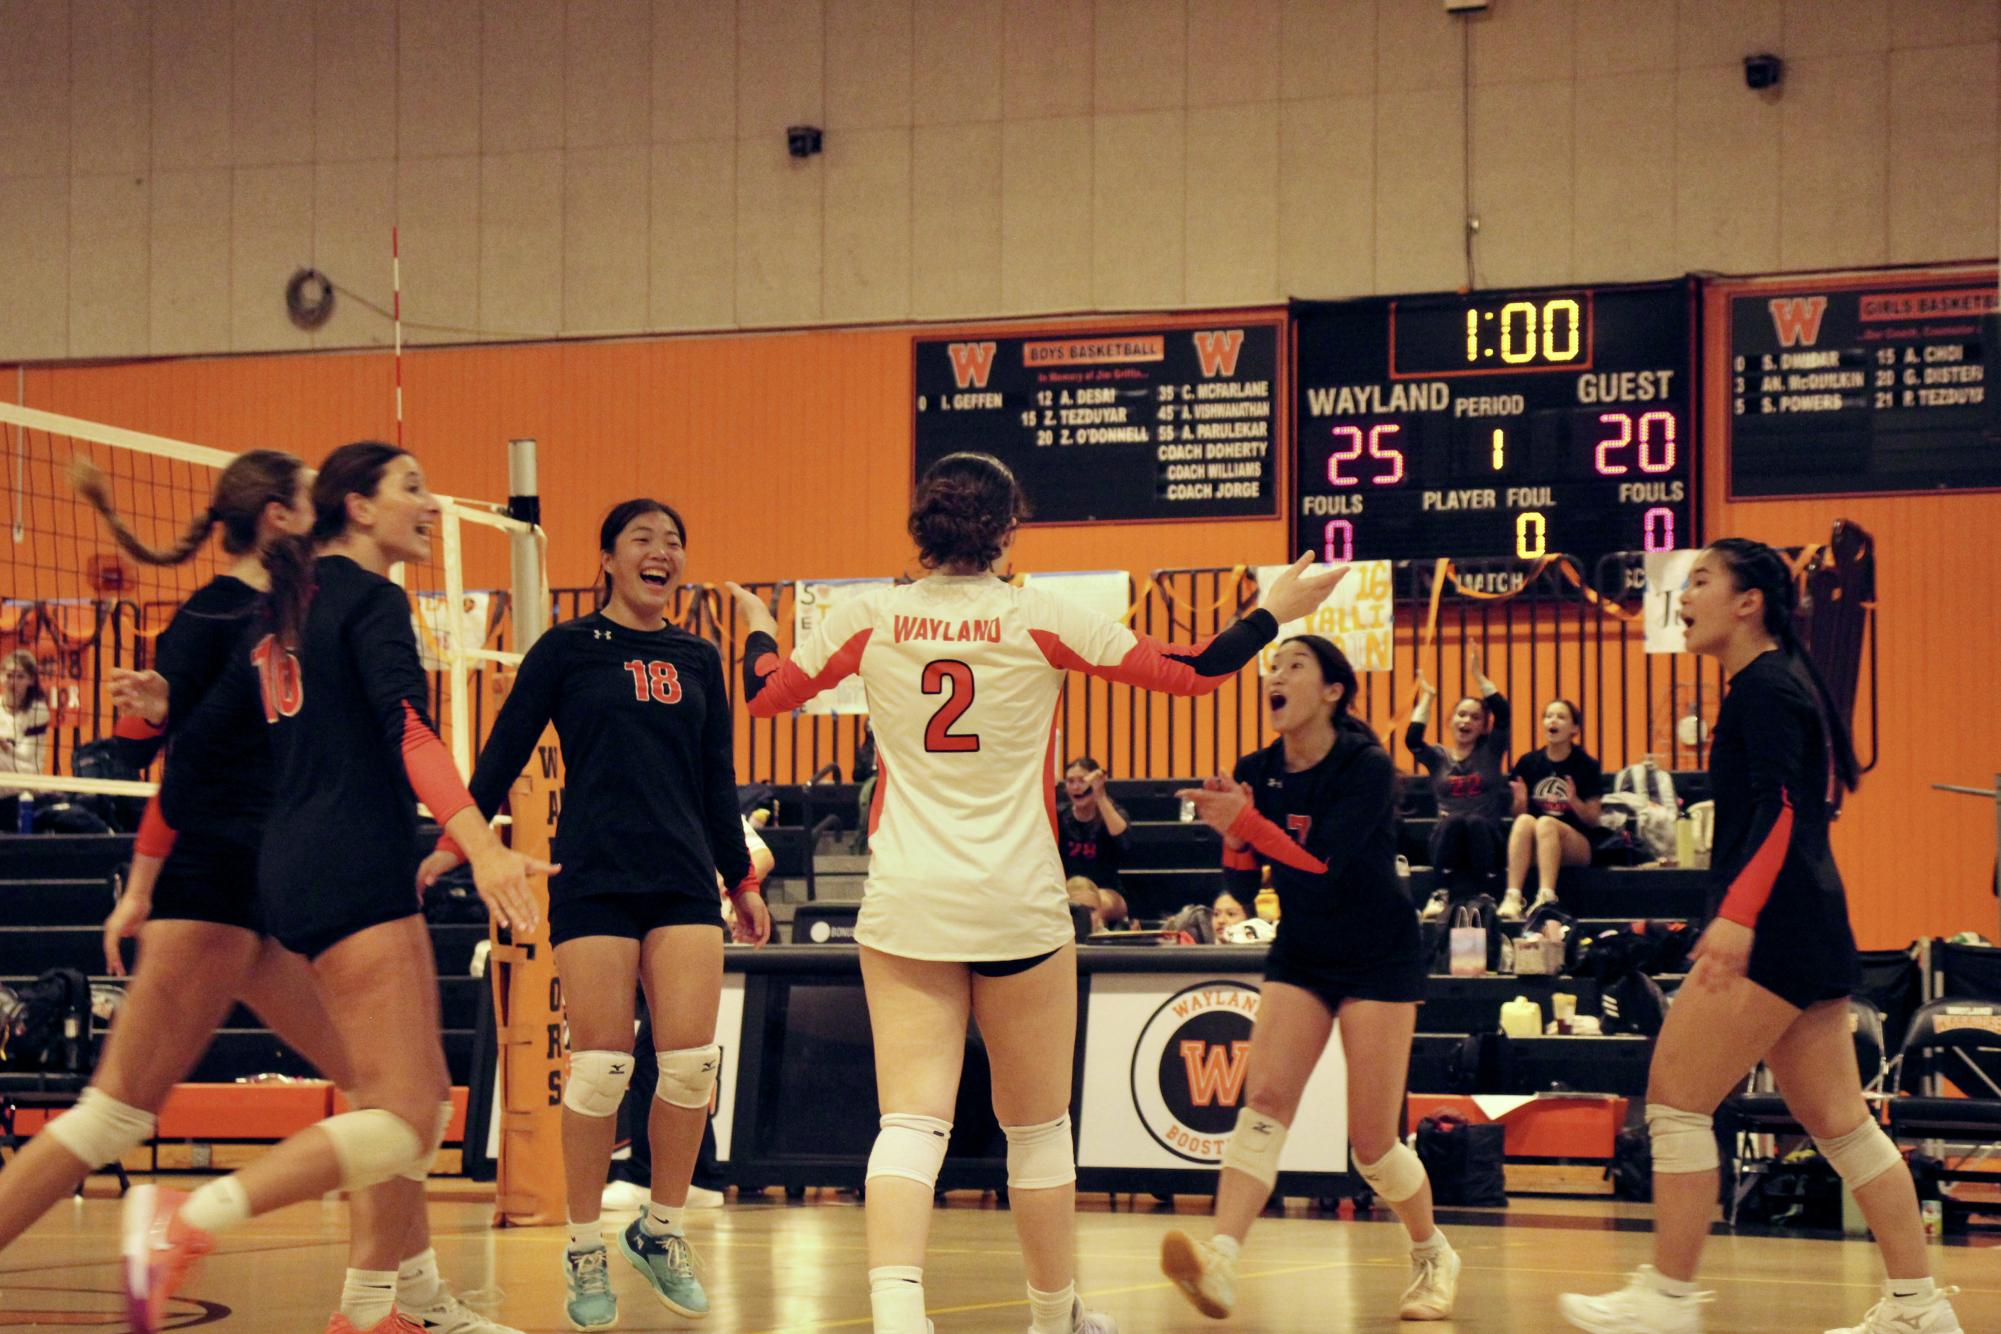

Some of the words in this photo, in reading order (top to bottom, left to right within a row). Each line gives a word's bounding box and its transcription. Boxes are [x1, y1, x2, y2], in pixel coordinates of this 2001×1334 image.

[1467, 299, 1580, 363] 1:00
[1768, 296, 1827, 347] W
[947, 342, 996, 388] W
[1031, 346, 1064, 361] BOYS
[1070, 343, 1157, 359] BASKETBALL
[1194, 329, 1244, 377] W
[1037, 391, 1052, 406] 12
[1060, 390, 1073, 405] A.
[1181, 384, 1195, 399] C.
[1577, 370, 1674, 404] GUEST
[1734, 376, 1745, 393] 3
[953, 392, 1002, 409] GEFFEN
[1157, 404, 1174, 420] 45
[1181, 404, 1192, 419] A.
[1307, 382, 1450, 417] WAYLAND
[1454, 395, 1524, 417] PERIOD
[1734, 398, 1745, 415] 5
[1021, 412, 1036, 427] 15
[1044, 410, 1056, 426] Z.
[1060, 408, 1127, 424] TEZDUYAR
[1158, 425, 1174, 441] 55
[1181, 424, 1194, 440] A.
[1197, 421, 1268, 439] PARULEKAR
[1037, 431, 1053, 446] 20
[1060, 430, 1073, 445] Z.
[1077, 427, 1148, 444] O'DONNELL
[1492, 428, 1504, 470] 1
[1595, 411, 1676, 475] 20
[1158, 444, 1202, 461] COACH
[1205, 441, 1268, 459] DOHERTY
[1328, 424, 1404, 486] 25
[1167, 464, 1205, 480] COACH
[1207, 462, 1262, 478] WILLIAMS
[1167, 484, 1212, 500] COACH
[1216, 482, 1260, 498] JORGE
[1422, 489, 1496, 511] PLAYER
[1506, 487, 1556, 508] FOUL
[1619, 481, 1684, 503] FOULS
[1303, 495, 1364, 516] FOULS
[1325, 519, 1354, 563] 0
[1516, 512, 1545, 559] 0
[1644, 507, 1674, 553] 0
[894, 614, 1001, 644] WAYLAND
[624, 659, 682, 704] 18
[921, 658, 981, 753] 2
[1172, 990, 1258, 1018] WAYLAN
[1180, 1039, 1250, 1107] W
[1165, 1124, 1230, 1156] BOOST
